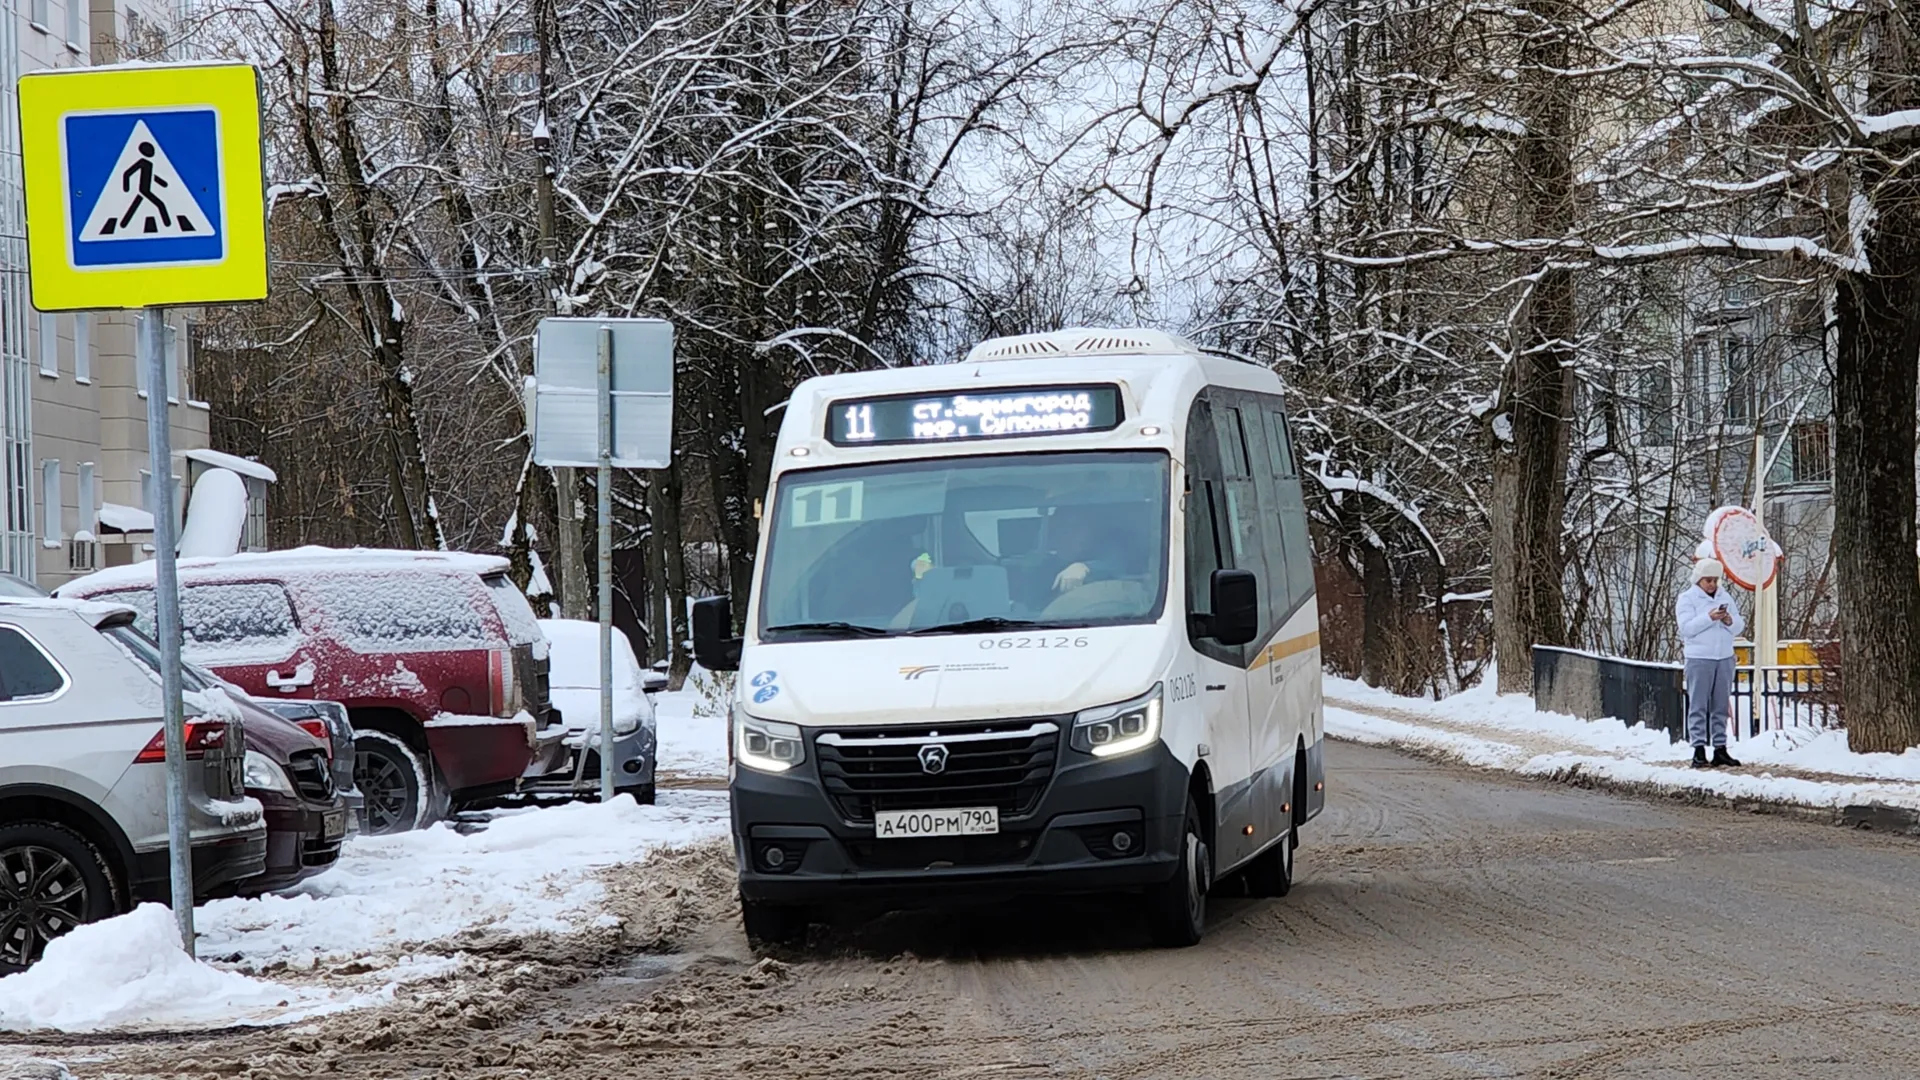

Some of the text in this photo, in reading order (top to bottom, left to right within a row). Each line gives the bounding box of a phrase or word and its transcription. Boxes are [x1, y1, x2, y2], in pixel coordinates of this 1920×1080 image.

[845, 405, 875, 439] 11
[980, 412, 1089, 434] Супонево
[795, 486, 853, 523] 11
[979, 636, 1089, 650] 062126
[1170, 673, 1197, 702] 062126
[962, 811, 992, 826] 790
